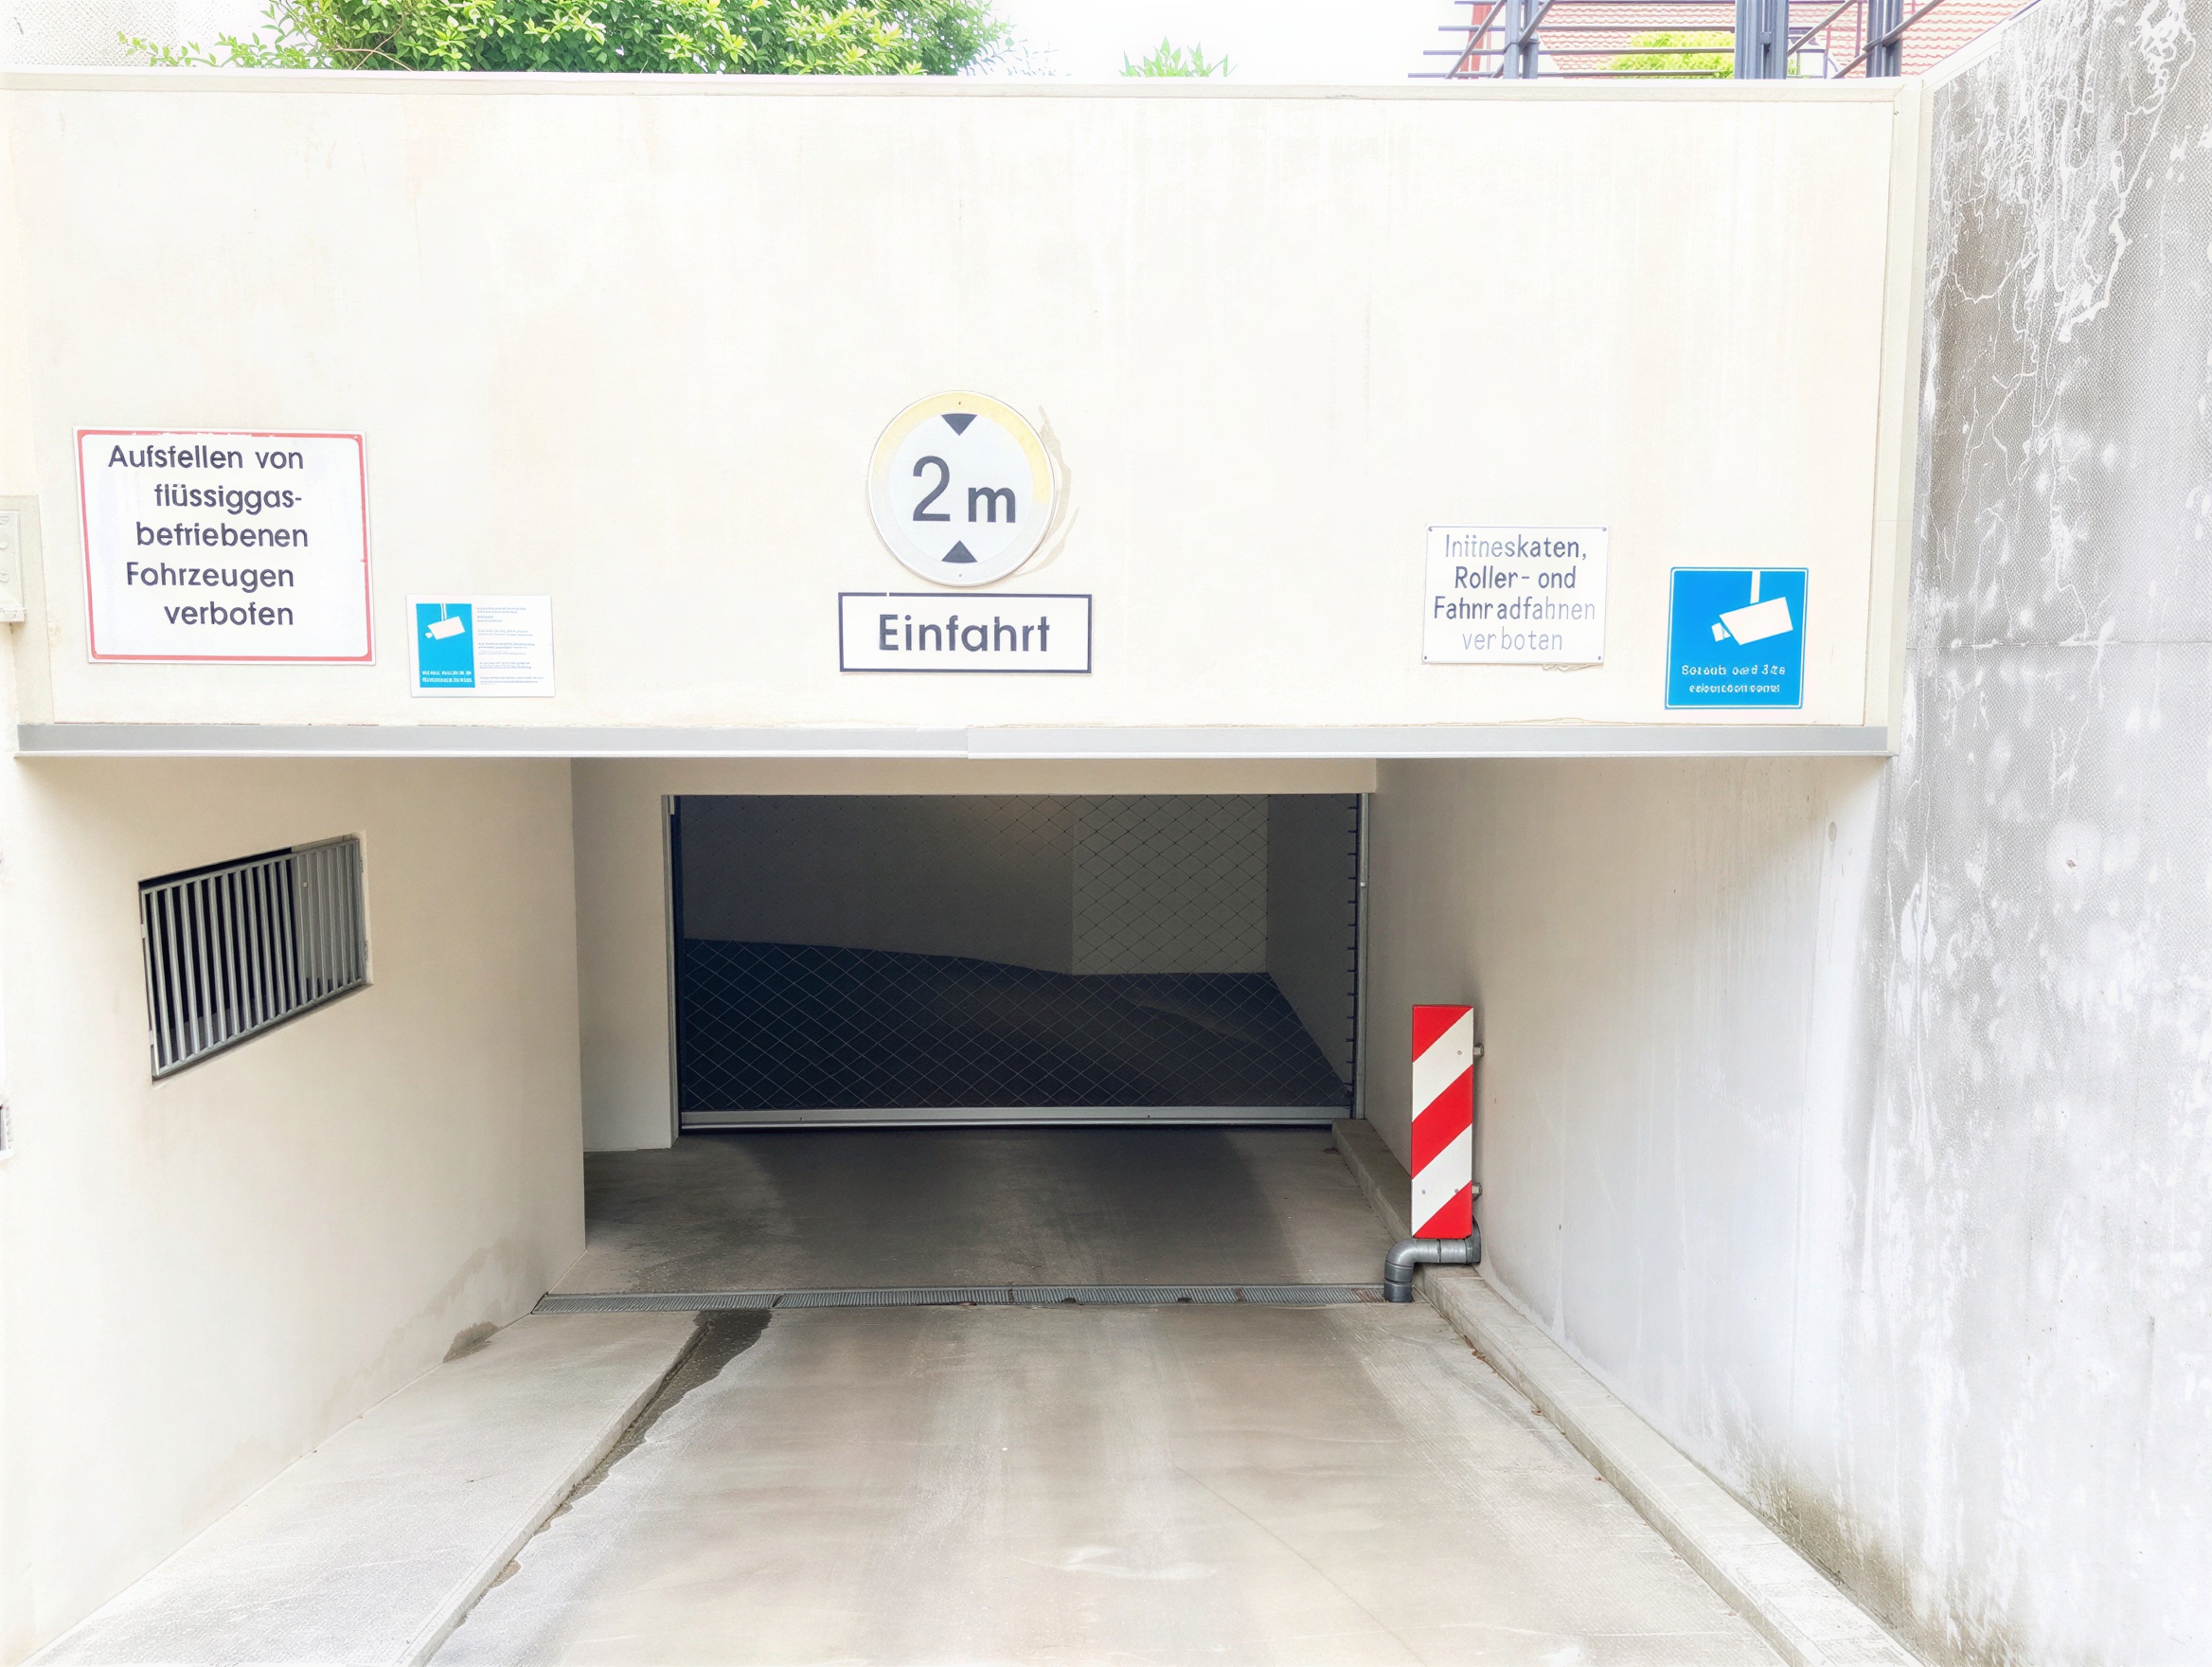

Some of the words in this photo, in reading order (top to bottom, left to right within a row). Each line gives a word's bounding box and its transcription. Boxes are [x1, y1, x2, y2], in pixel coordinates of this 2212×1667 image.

[255, 451, 304, 470] von
[153, 483, 302, 515] flüssiggas-
[912, 455, 951, 522] 2
[967, 486, 1016, 523] m
[1454, 565, 1530, 589] Roller-
[879, 614, 1050, 653] Einfahrt
